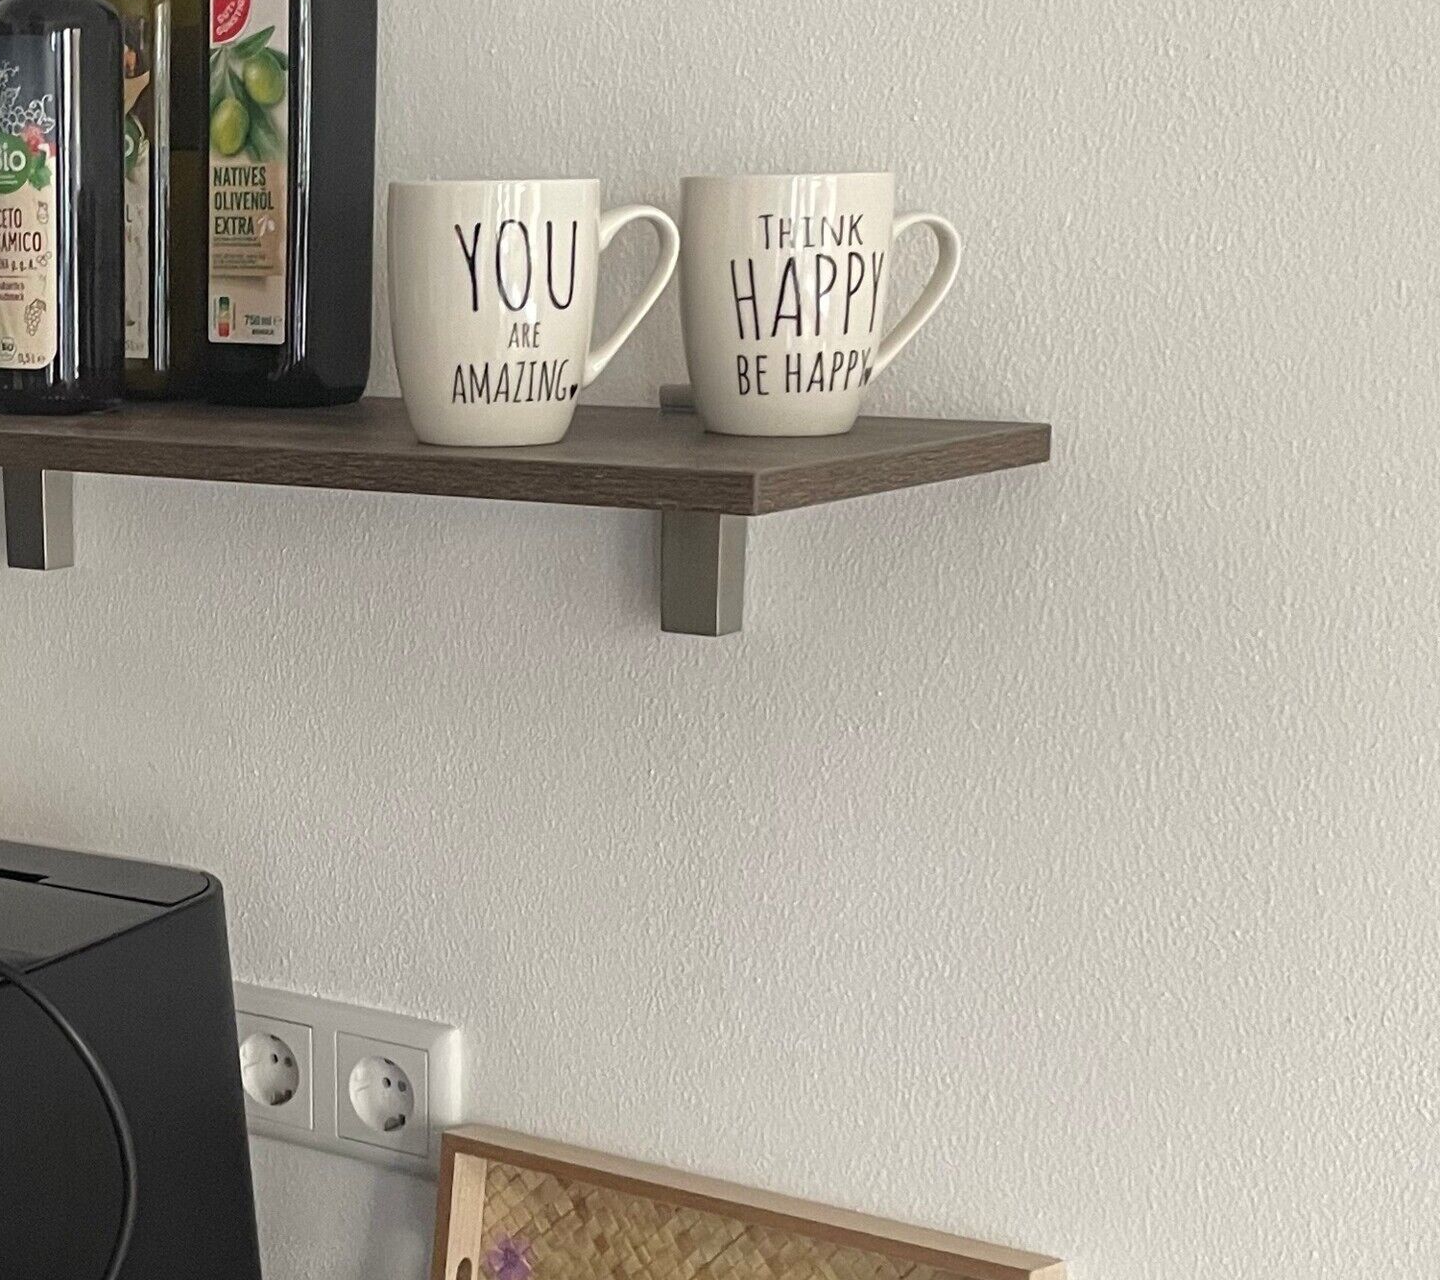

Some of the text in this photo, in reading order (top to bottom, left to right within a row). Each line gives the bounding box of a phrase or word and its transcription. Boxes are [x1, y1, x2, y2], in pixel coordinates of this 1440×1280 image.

[213, 166, 267, 187] NATIVES
[214, 188, 274, 211] OLIVENÖL
[215, 216, 255, 235] EXTRA
[758, 213, 864, 250] THINK
[454, 219, 578, 312] YOU
[730, 251, 885, 341] HAPPY
[507, 321, 541, 349] ARE
[451, 358, 570, 405] AMAZING
[736, 347, 872, 396] BE HAPPY
